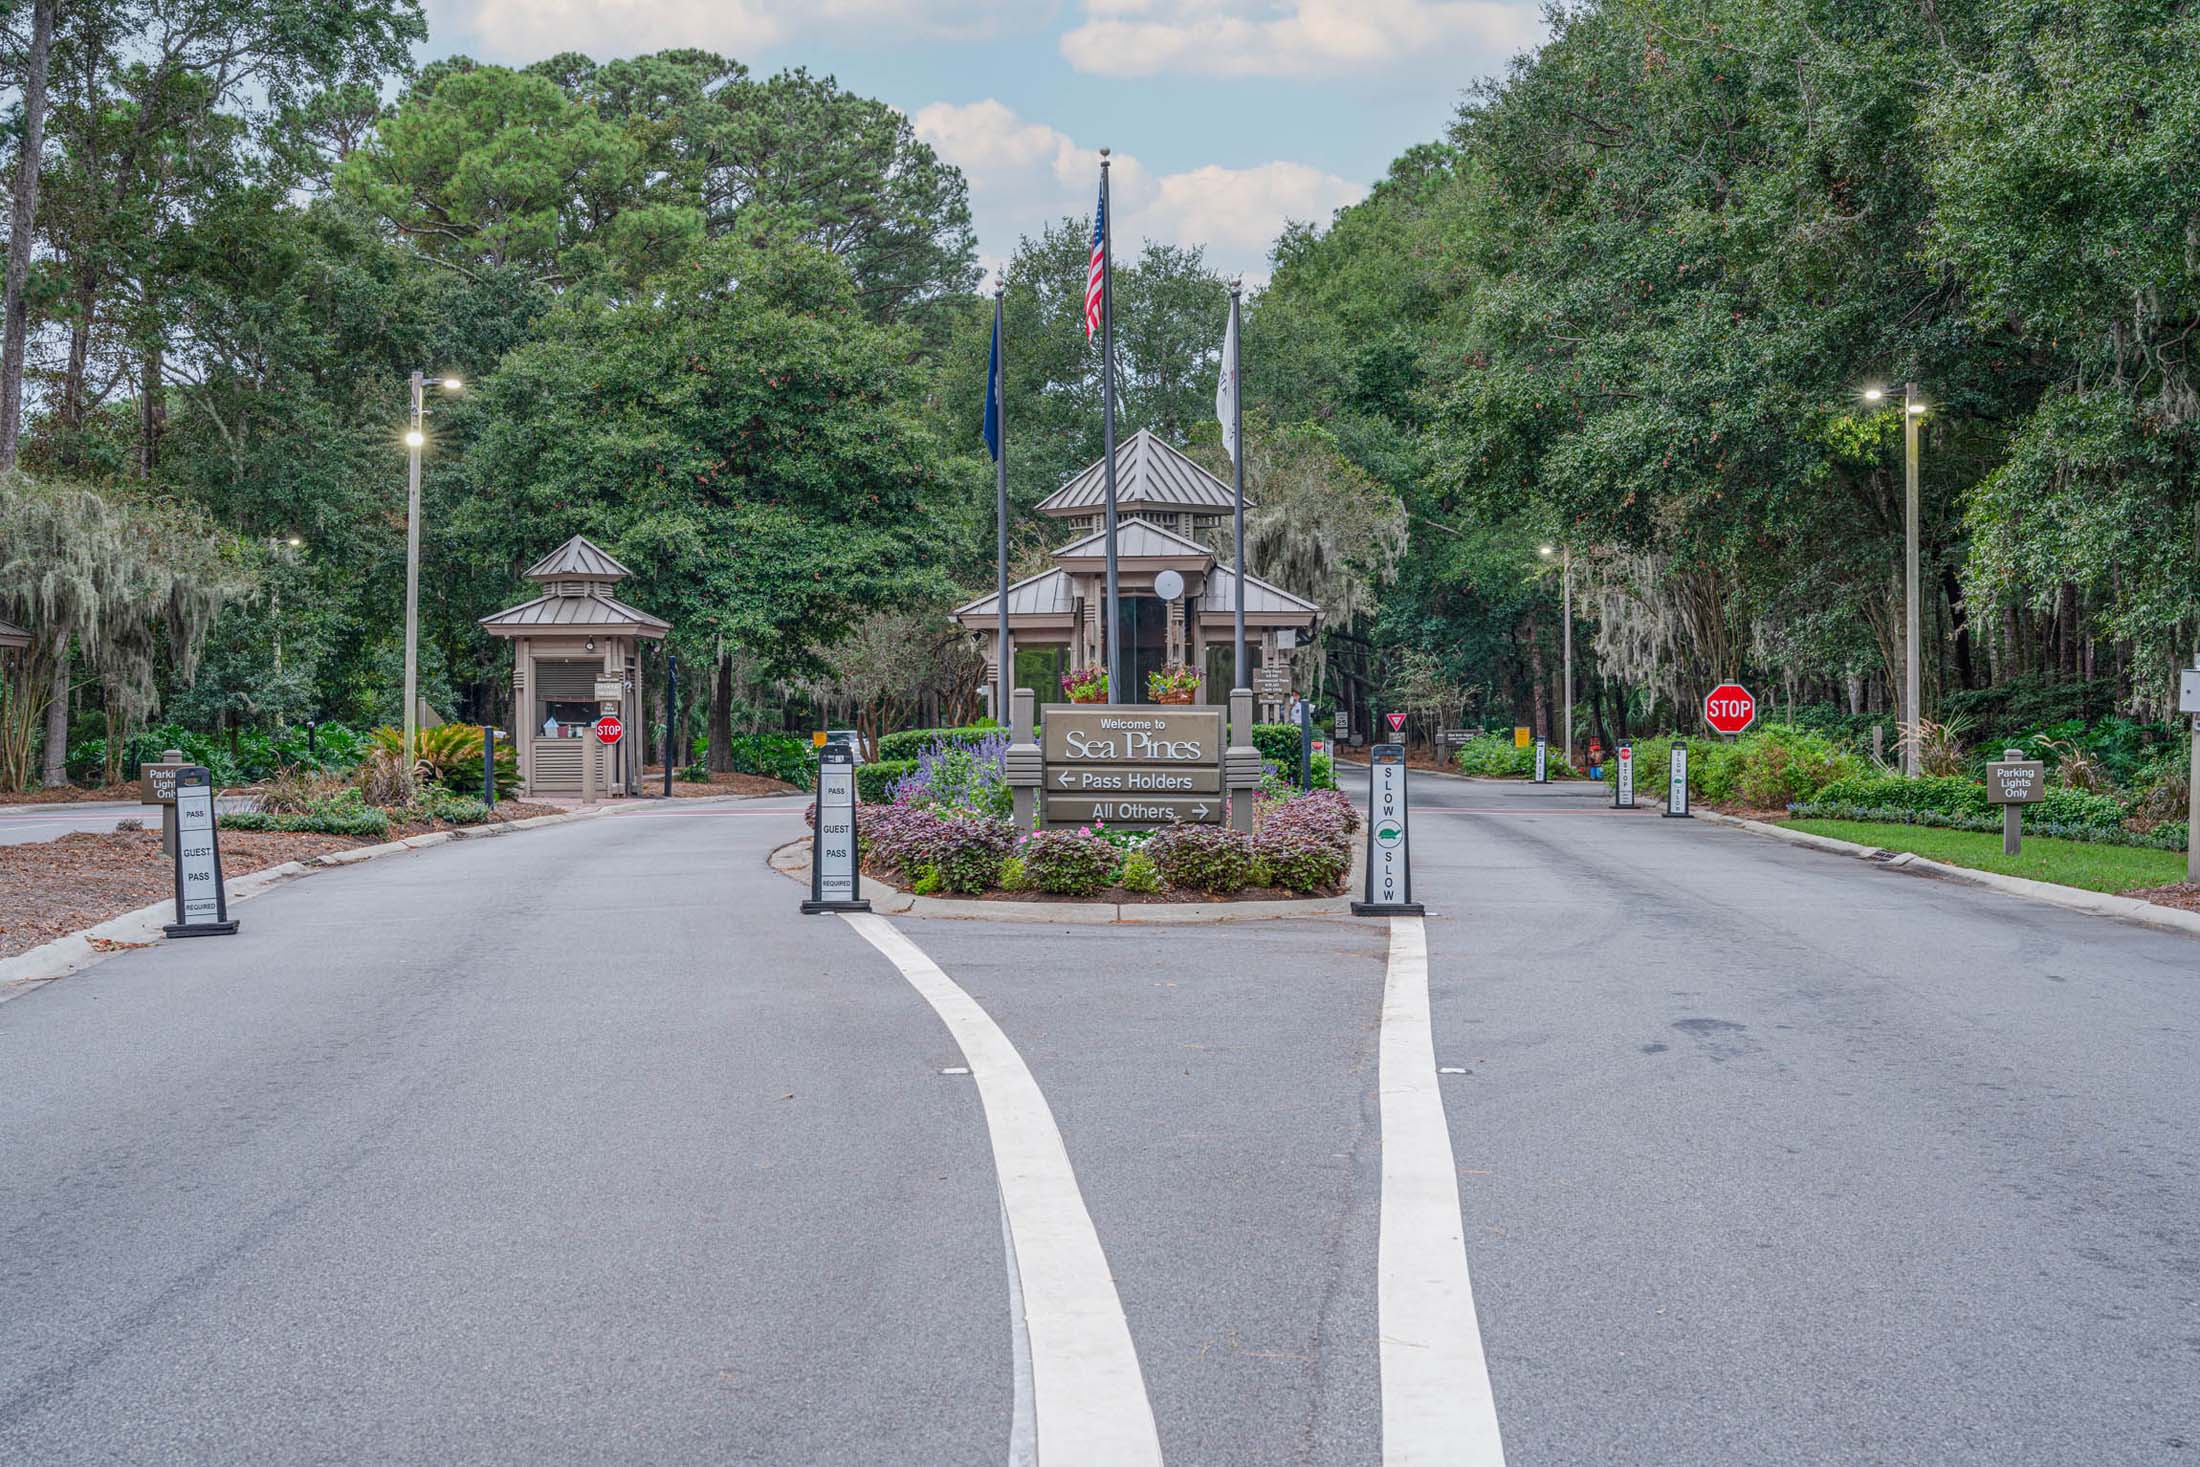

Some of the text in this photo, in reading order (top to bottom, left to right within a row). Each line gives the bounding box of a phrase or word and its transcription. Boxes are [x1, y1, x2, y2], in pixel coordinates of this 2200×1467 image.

[1710, 700, 1751, 718] STOP
[1100, 719, 1166, 730] Welcome to
[597, 725, 621, 736] STOP
[1065, 730, 1201, 760] Sea Pines
[150, 769, 176, 779] Parki
[1997, 768, 2035, 778] Parking
[153, 779, 176, 790] Light
[1082, 773, 1193, 789] Pass Holders
[2001, 778, 2031, 788] Lights
[828, 787, 845, 795] PASS
[1383, 767, 1394, 817] SLOW
[2005, 788, 2028, 798] Only
[186, 810, 204, 818] PASS
[1092, 803, 1175, 818] All Others
[823, 824, 849, 834] GUEST
[183, 847, 211, 857] GUEST
[826, 849, 847, 858] PASS
[188, 872, 210, 881] PASS
[1383, 851, 1394, 901] SLOW
[186, 903, 216, 911] REQUIRED
